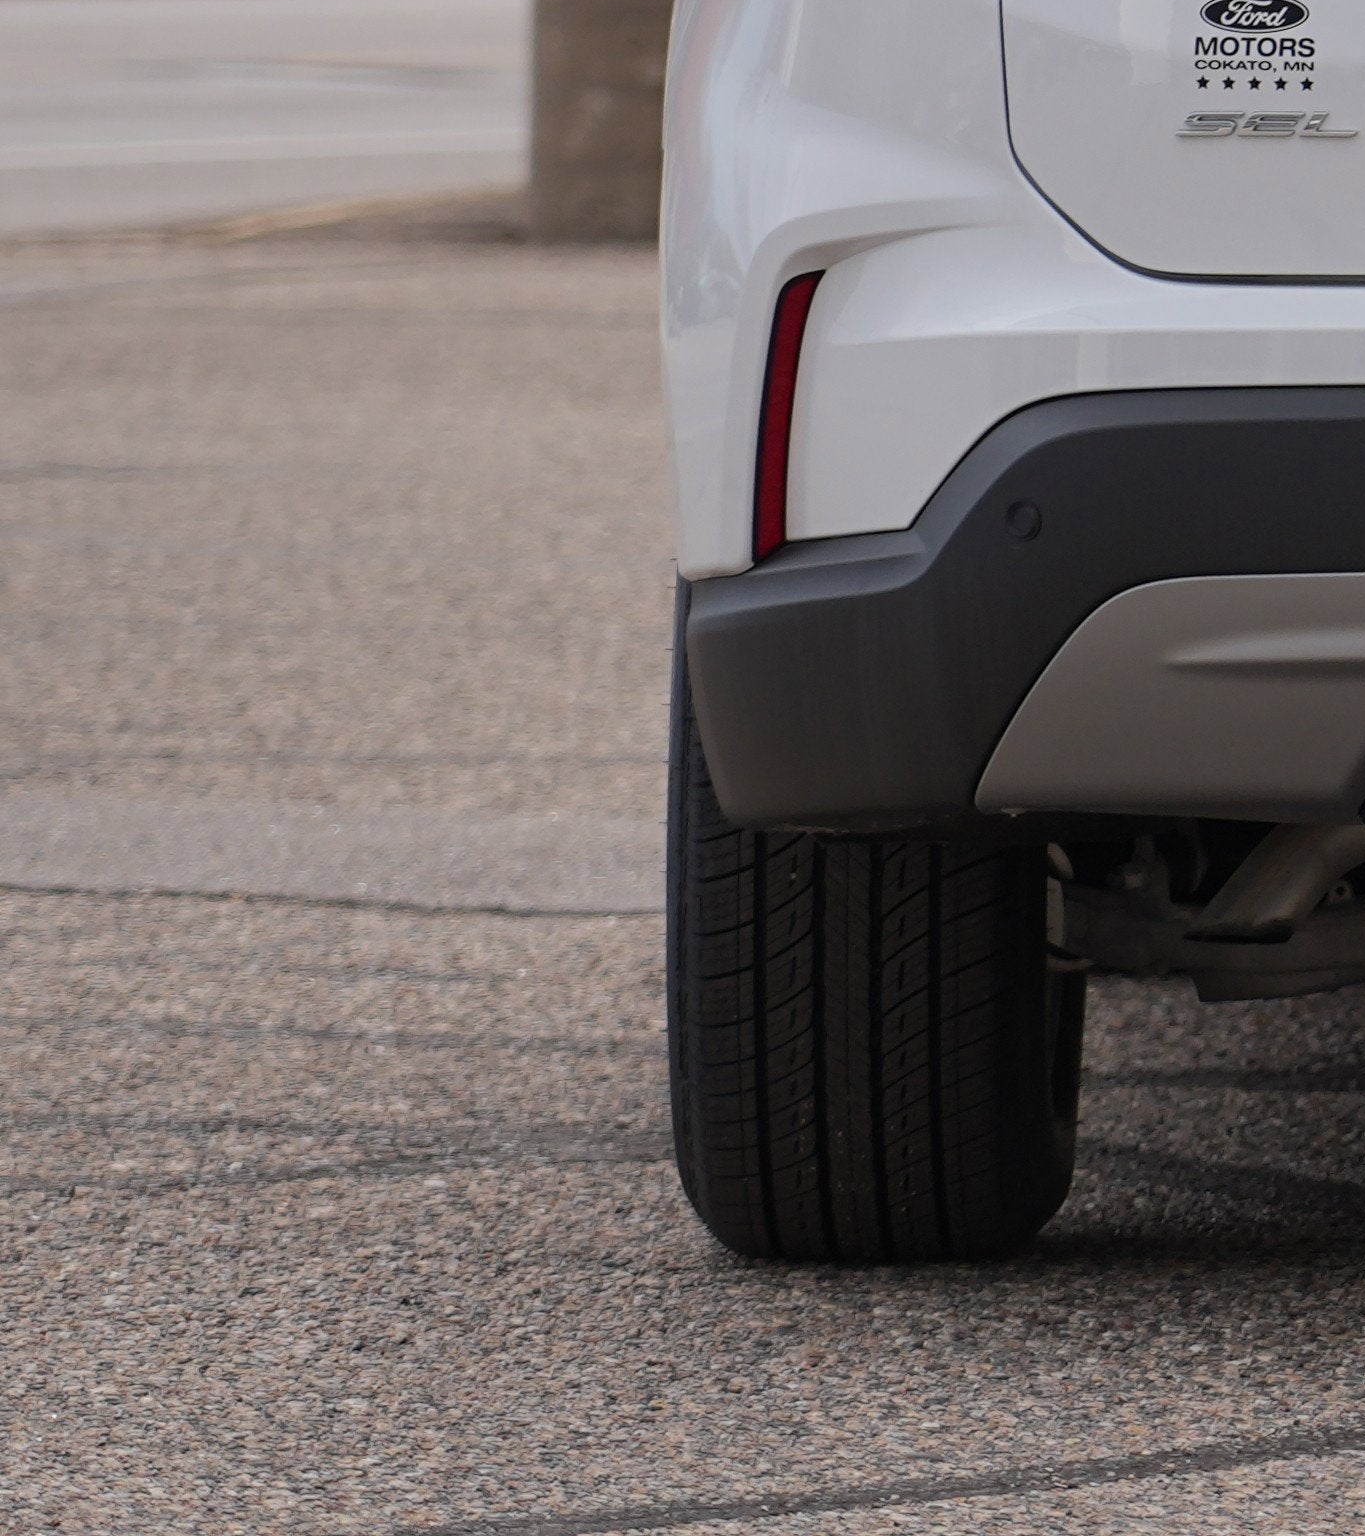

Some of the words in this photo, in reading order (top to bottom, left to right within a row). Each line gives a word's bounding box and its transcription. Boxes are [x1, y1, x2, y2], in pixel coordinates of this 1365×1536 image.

[1194, 37, 1316, 57] MOTORS
[1194, 60, 1277, 73] COKATO,
[1283, 61, 1314, 72] MN
[1175, 110, 1360, 138] SEL
